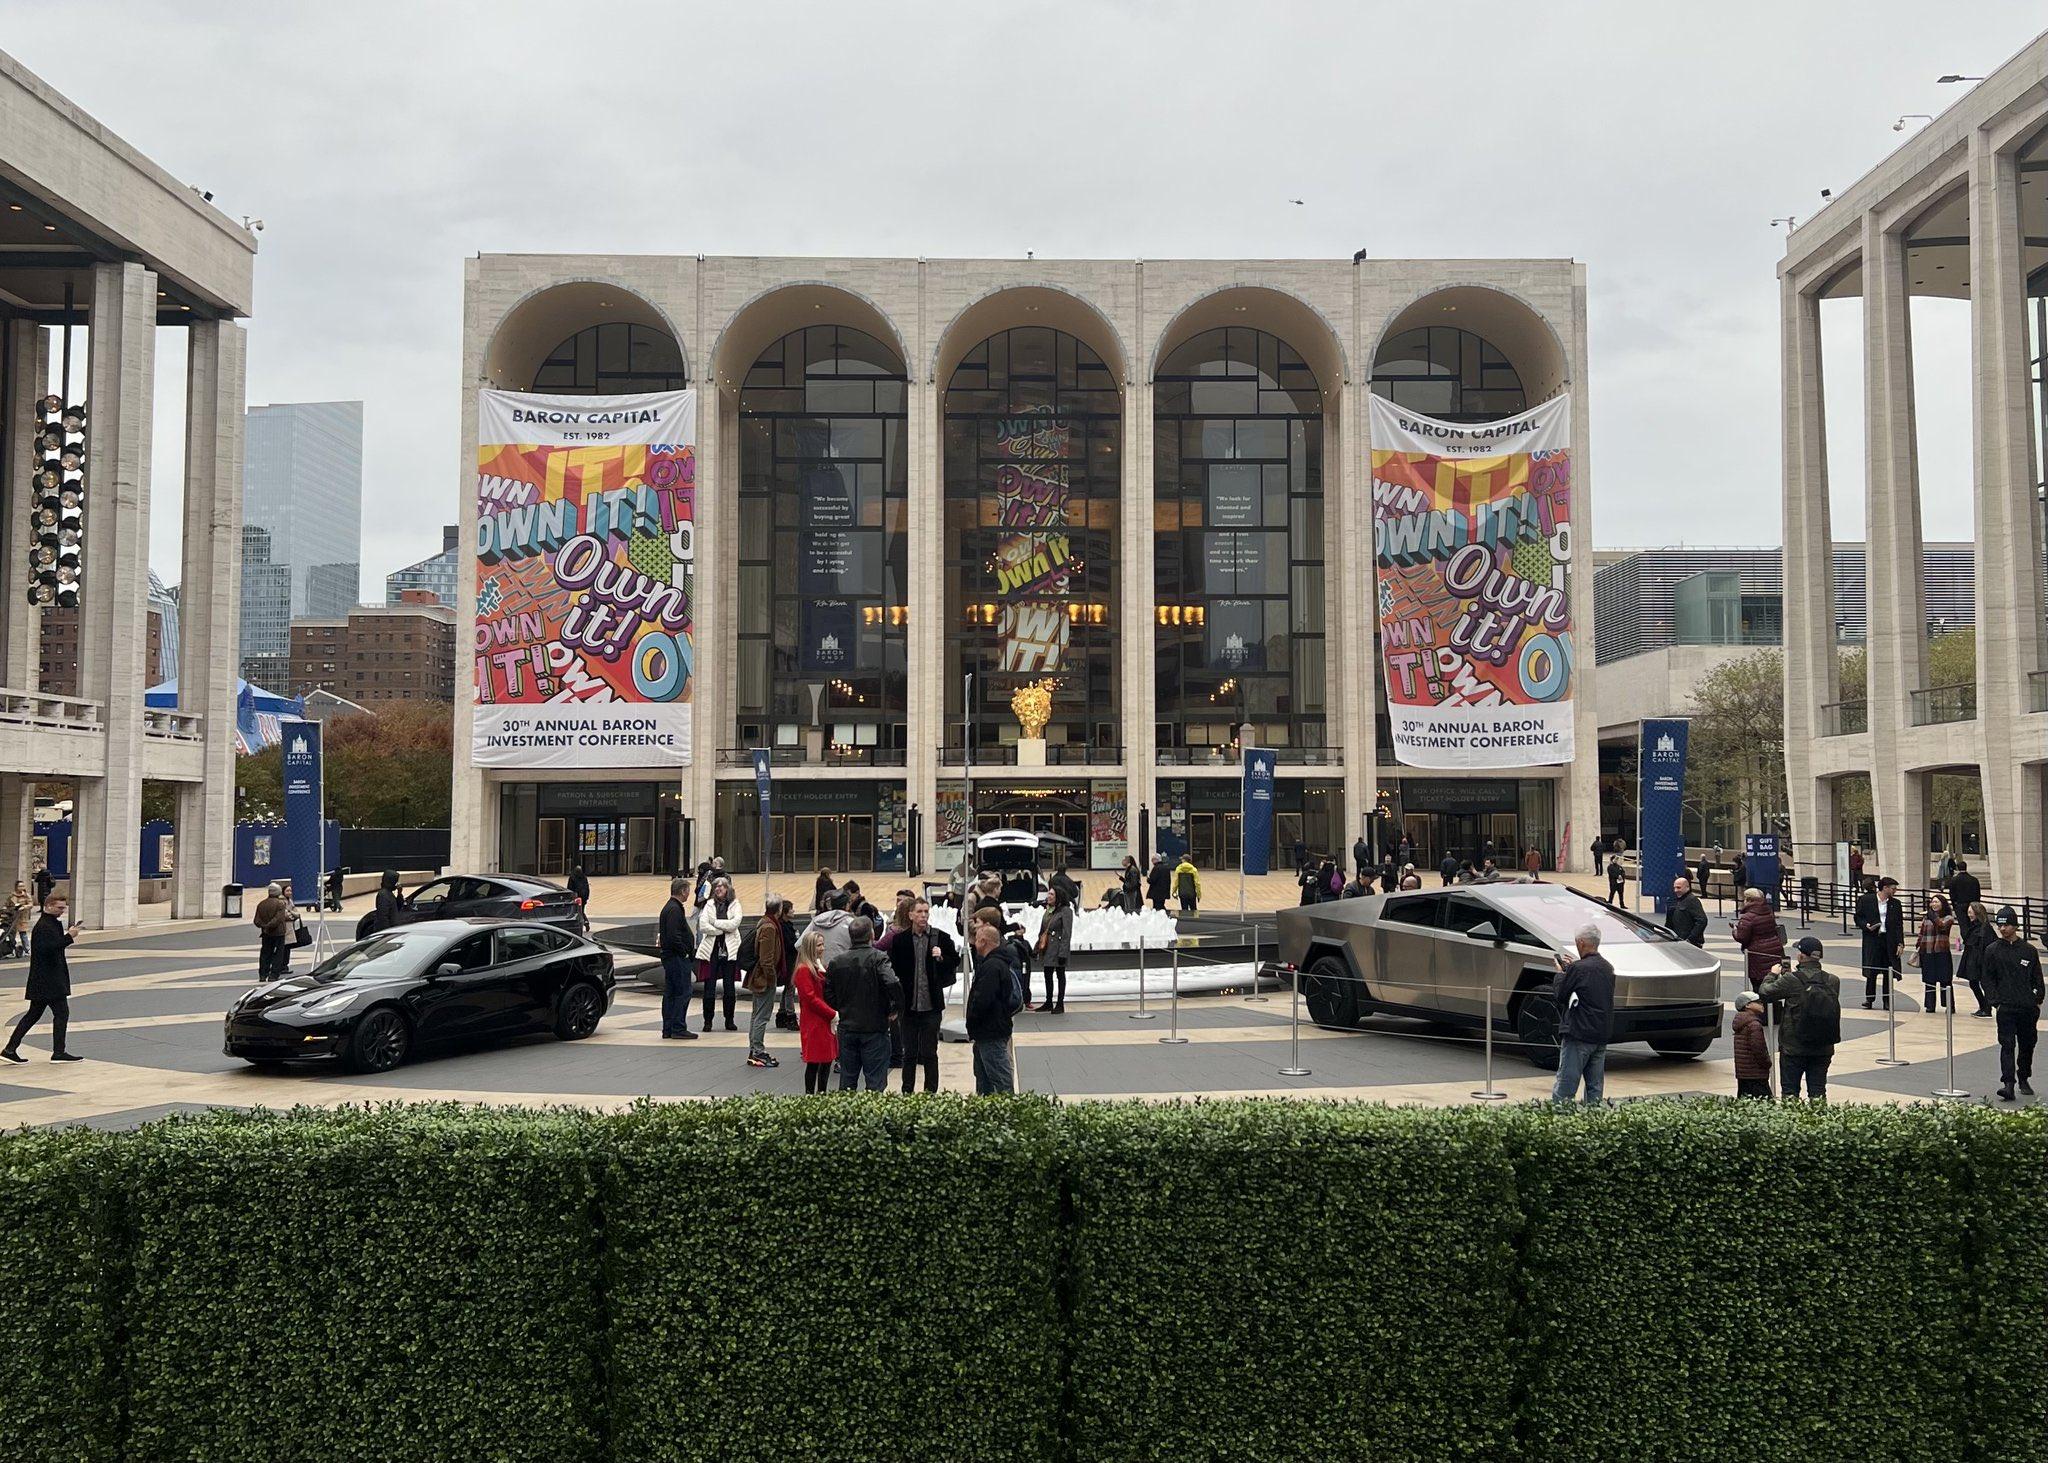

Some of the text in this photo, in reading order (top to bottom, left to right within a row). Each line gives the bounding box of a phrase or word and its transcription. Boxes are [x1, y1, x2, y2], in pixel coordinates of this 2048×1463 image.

[512, 409, 661, 424] BARON CAPITAL
[1399, 418, 1540, 439] BARON CAPITAL
[563, 432, 610, 440] EST. 1982
[1446, 445, 1492, 453] EST. 1982
[478, 473, 536, 506] WN
[1373, 478, 1428, 512] WN
[477, 484, 655, 561] OWN IT!
[1476, 492, 1535, 543] IT!
[555, 535, 687, 625] Own
[1446, 544, 1568, 627] Own
[475, 610, 547, 652] OWN
[561, 594, 639, 659] it!
[1450, 601, 1524, 663] it!
[475, 644, 554, 703] IT!
[487, 734, 674, 747] INVESTMENT CONFERENCE
[502, 719, 657, 732] 30TH ANNUAL BARON
[1395, 732, 1559, 748] INVESTMENT CONFERENCE
[1402, 719, 1545, 734] 30TH ANNUAL BARON
[578, 799, 618, 807] ENTRANCE
